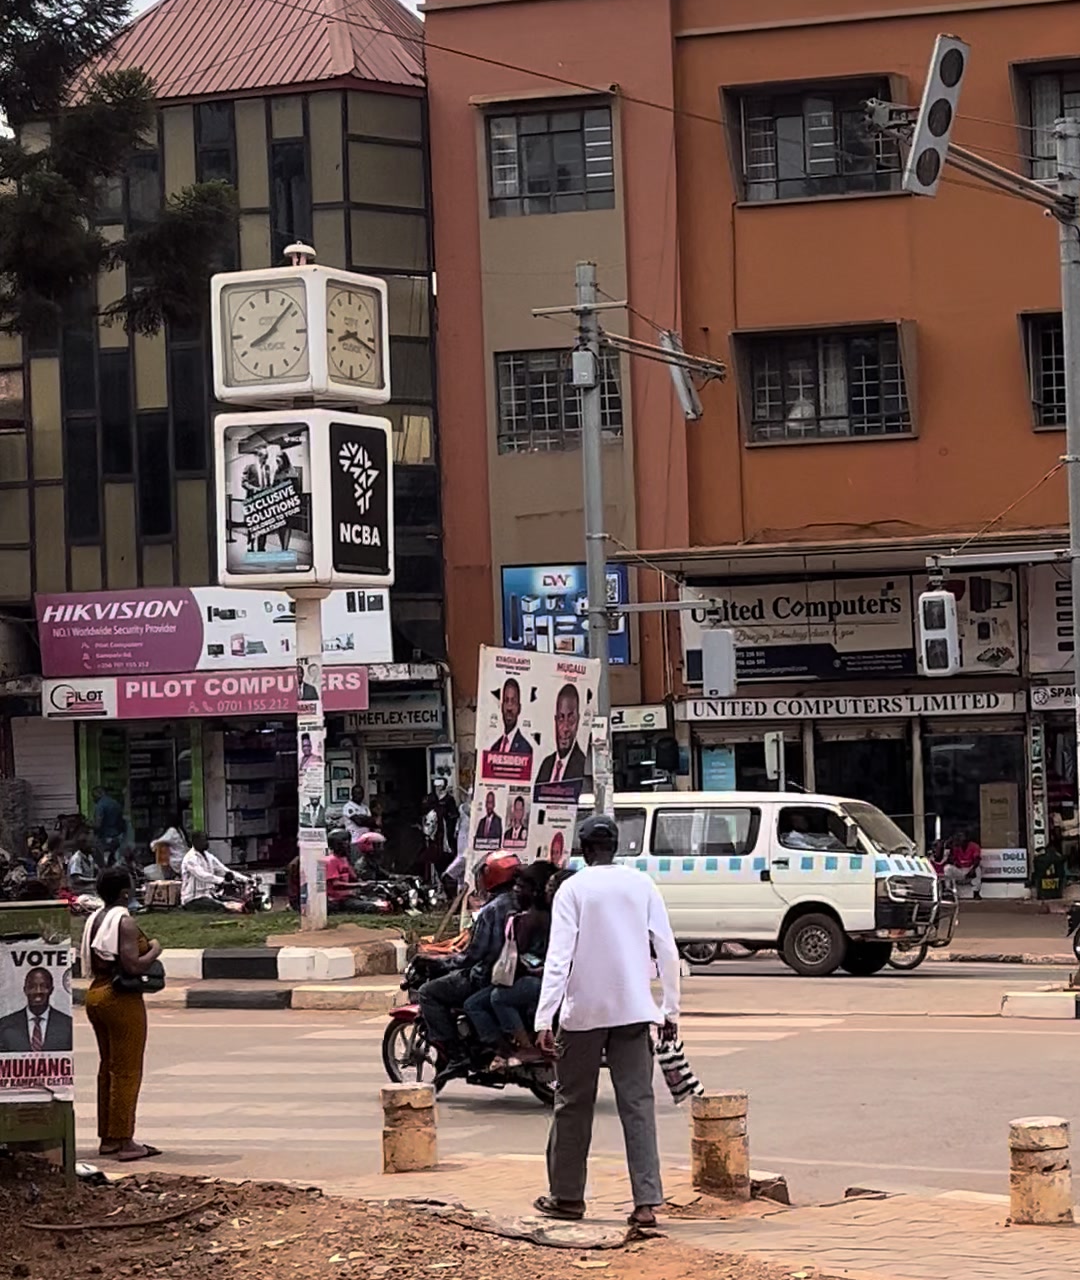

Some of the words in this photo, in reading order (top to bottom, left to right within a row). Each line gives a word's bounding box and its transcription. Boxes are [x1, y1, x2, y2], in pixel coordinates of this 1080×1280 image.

[243, 485, 295, 515] EXCLUSIVE
[246, 495, 301, 526] SOLUTIONS
[340, 522, 381, 547] NCBA
[42, 599, 184, 623] HIKVISION
[772, 595, 901, 622] Computers
[72, 626, 112, 637] Worldwide
[113, 625, 144, 636] Security
[145, 624, 177, 634] Provider
[126, 680, 196, 699] PILOT
[204, 672, 361, 696] COMPUERS
[217, 700, 243, 711] 0701
[249, 699, 266, 710] 155
[268, 698, 289, 710] 212
[693, 701, 767, 718] UNITED
[773, 697, 902, 716] COMPUTERS
[909, 693, 999, 712] LIMITED
[11, 951, 67, 967] VOTE
